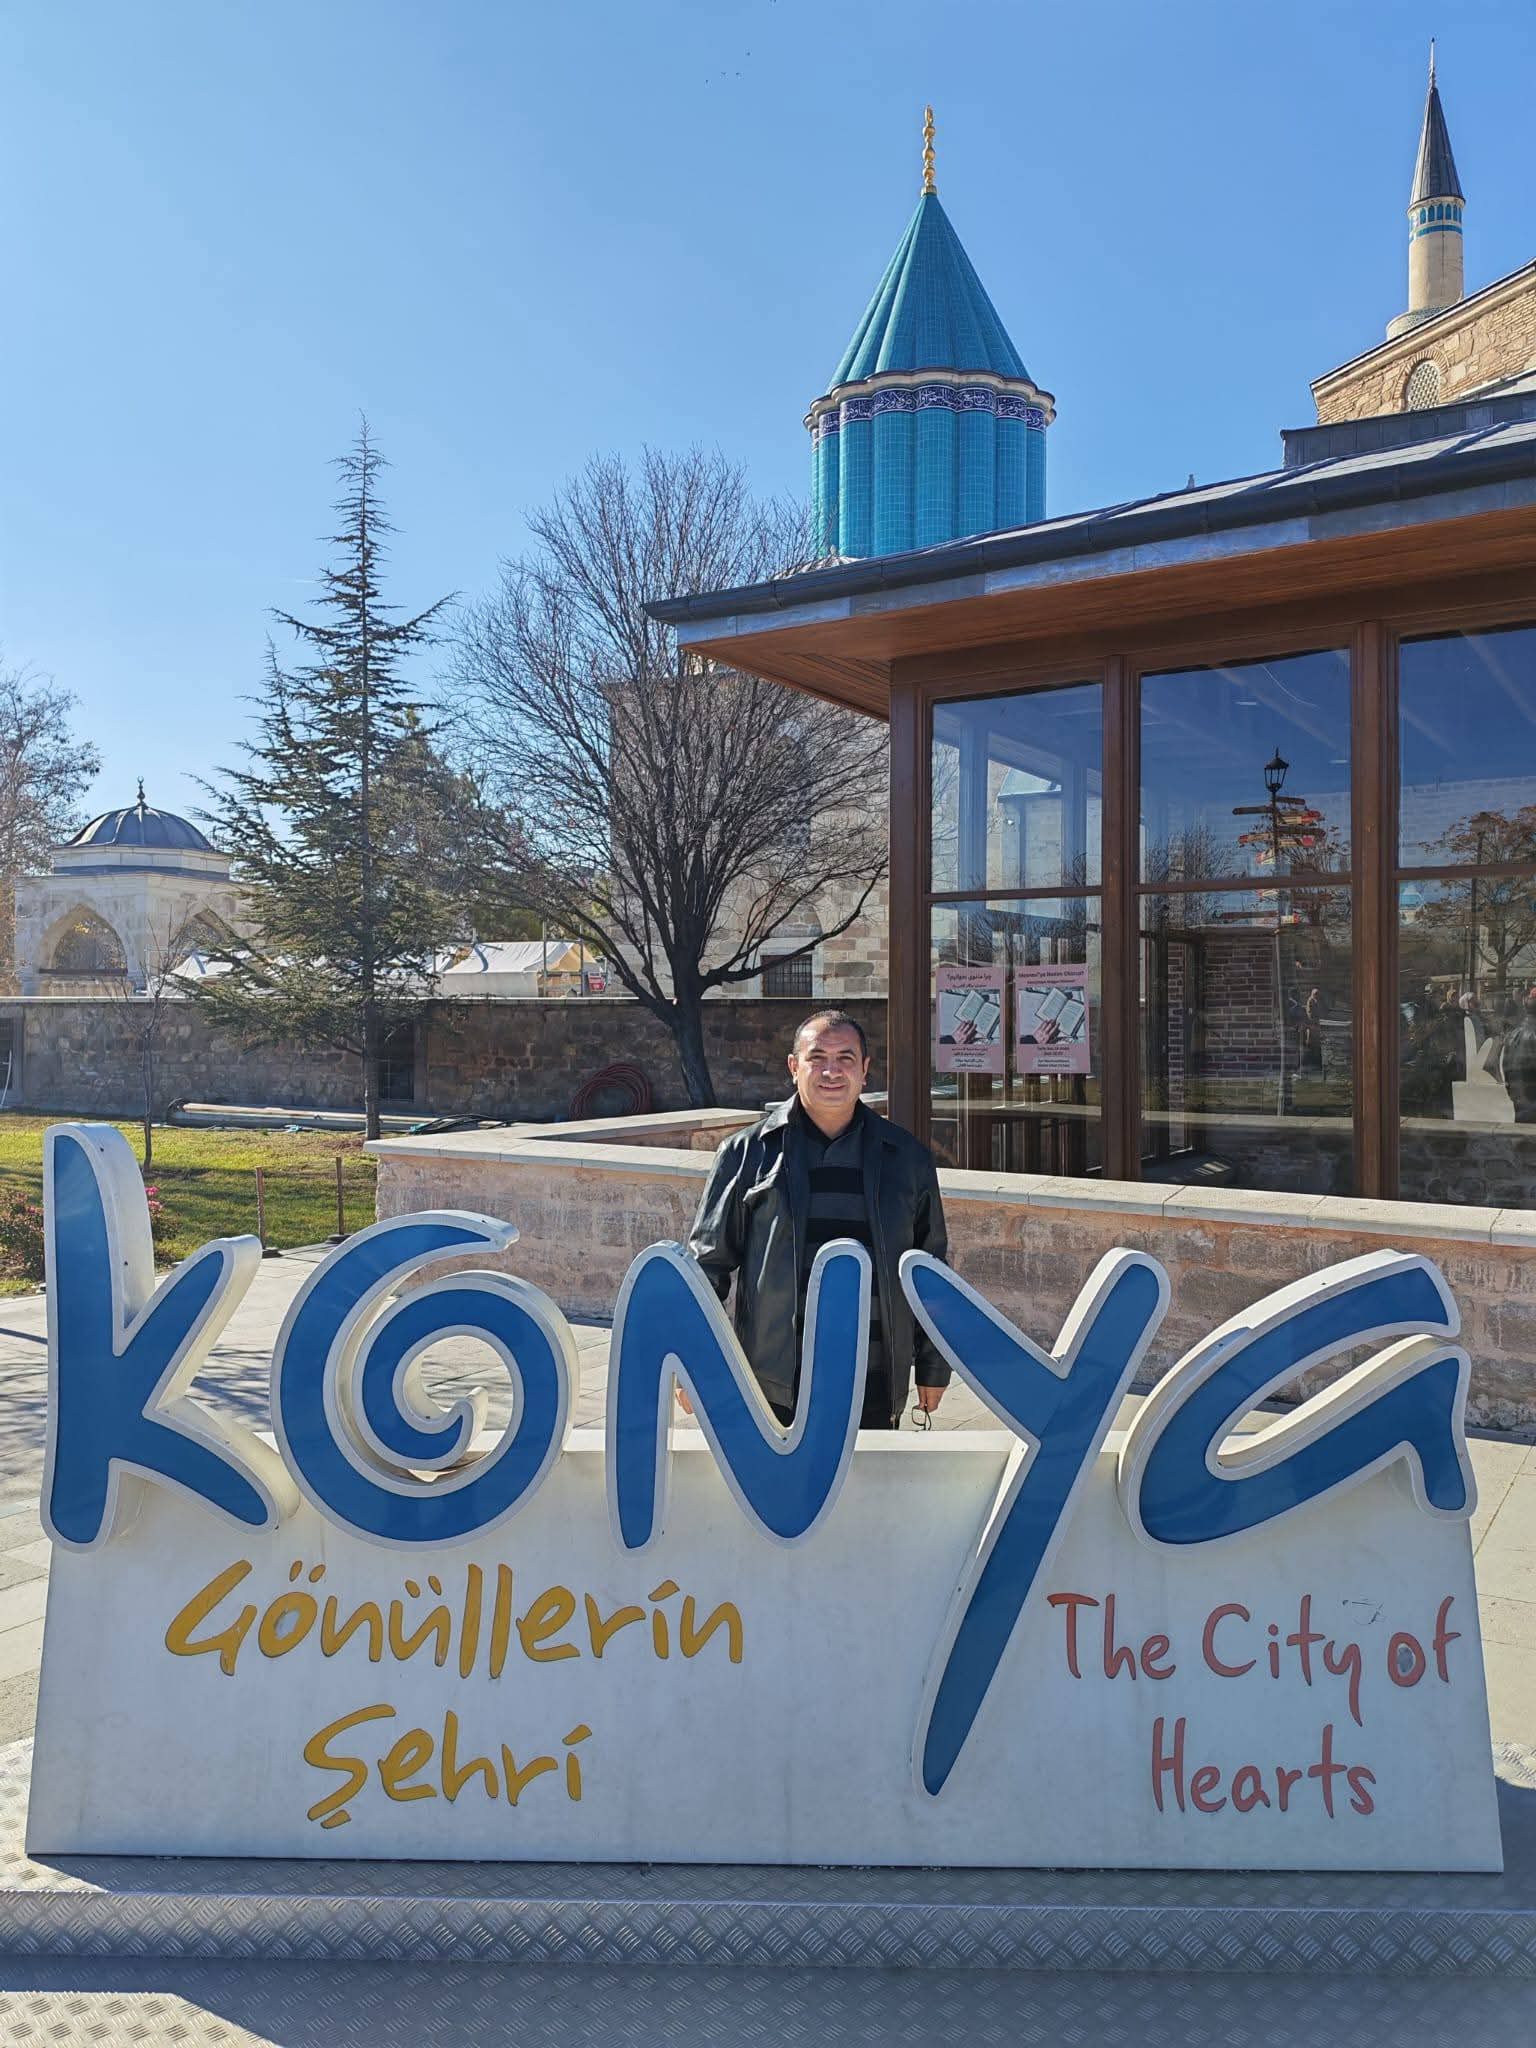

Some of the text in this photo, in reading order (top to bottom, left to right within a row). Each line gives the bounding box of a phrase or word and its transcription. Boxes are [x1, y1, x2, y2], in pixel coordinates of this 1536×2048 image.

[164, 1559, 743, 1680] Gönüllerin
[1047, 1593, 1462, 1727] The City of
[303, 1703, 592, 1829] Şehri
[1151, 1716, 1377, 1819] Hearts
